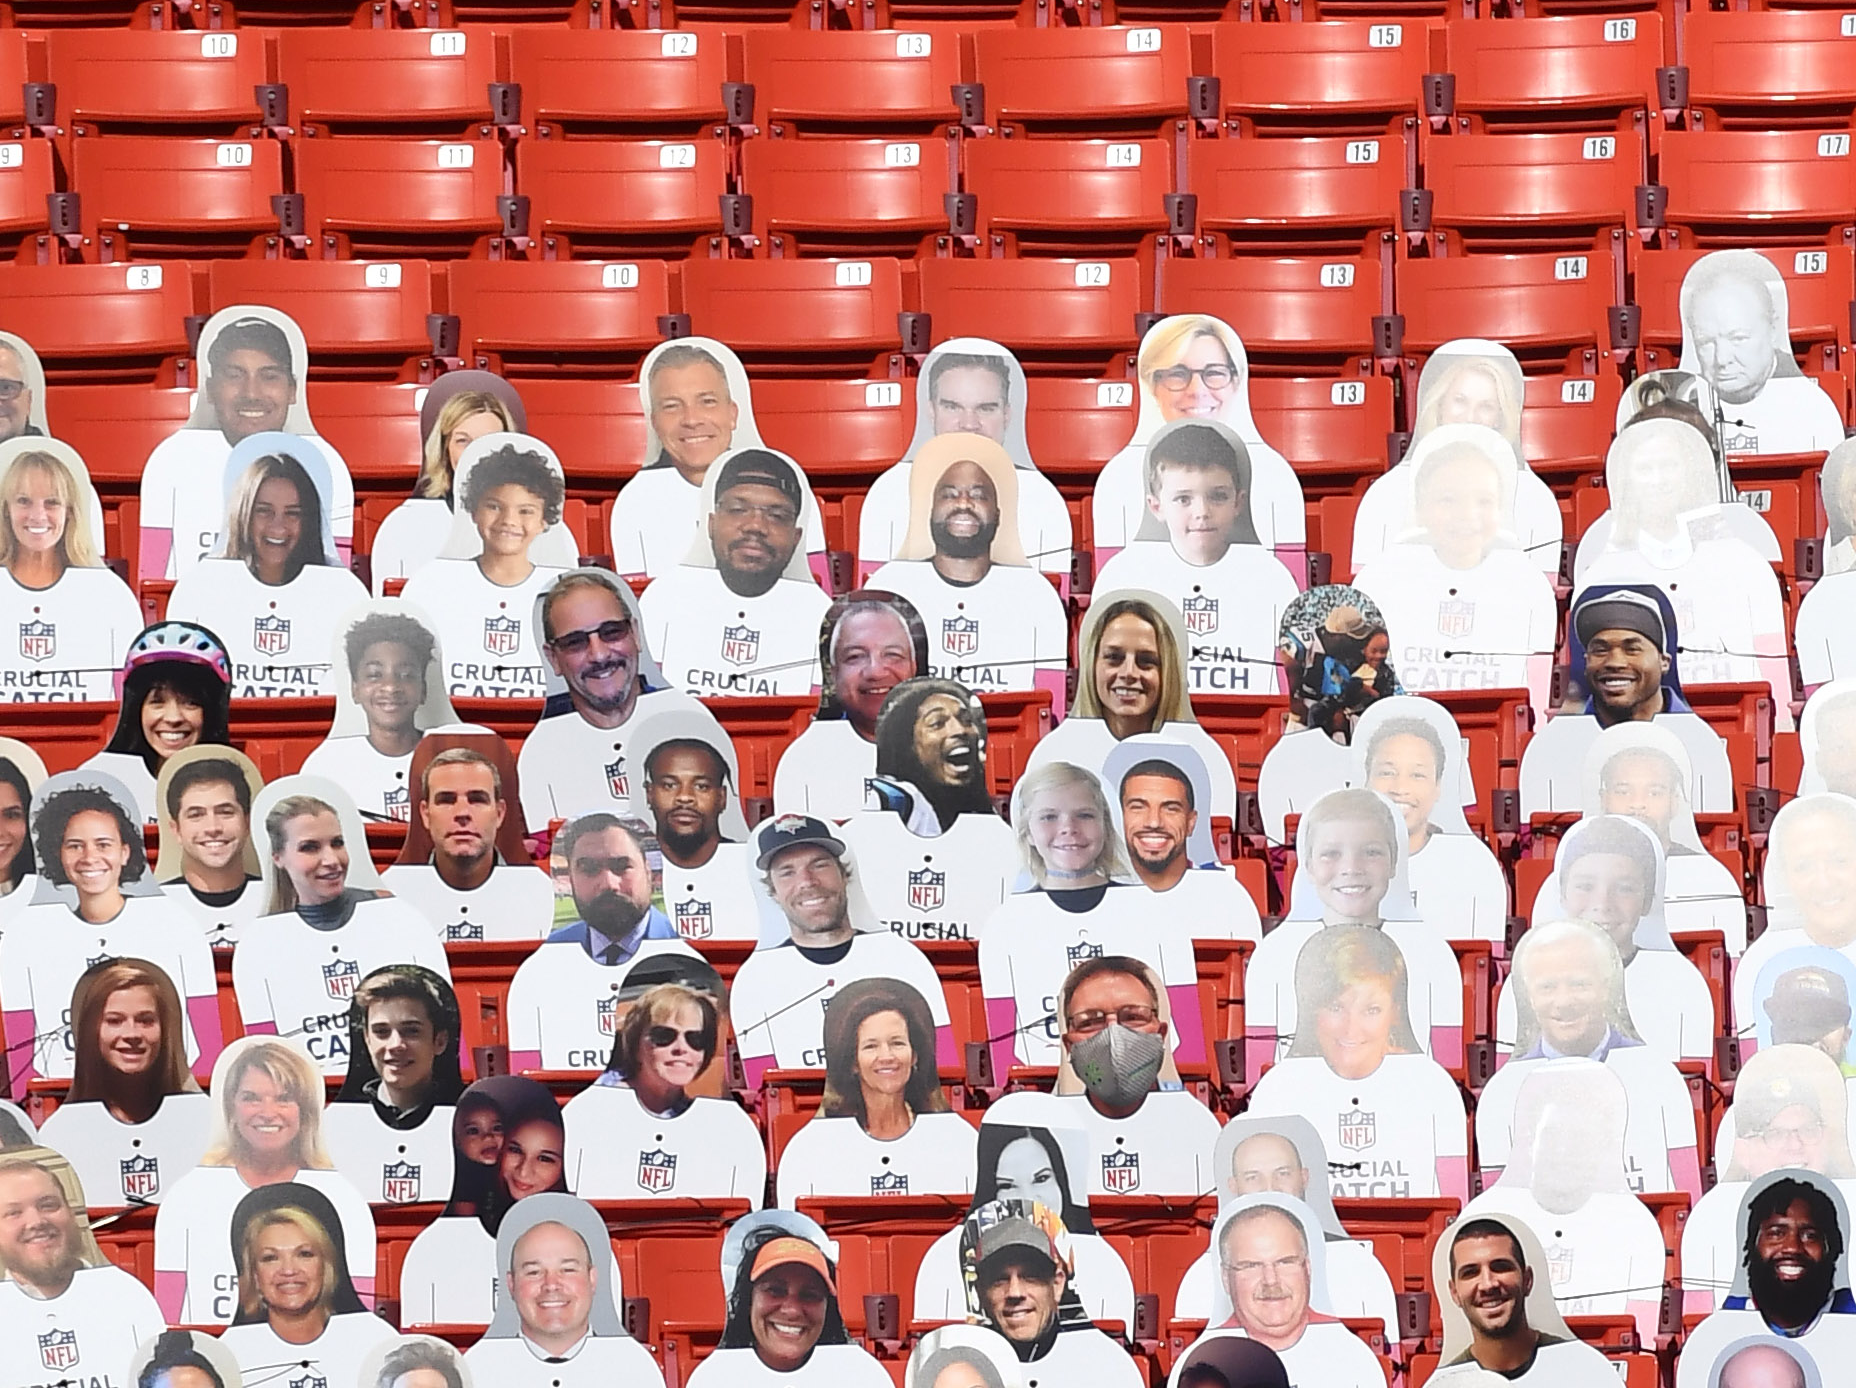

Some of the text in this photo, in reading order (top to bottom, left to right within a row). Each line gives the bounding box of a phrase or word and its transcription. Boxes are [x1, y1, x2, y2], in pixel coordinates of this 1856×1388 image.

[1377, 27, 1395, 45] 15
[1612, 21, 1629, 39] 16
[441, 36, 456, 53] 11
[1591, 139, 1609, 157] 16
[1825, 136, 1843, 154] 17
[1802, 254, 1820, 272] 15
[1330, 266, 1347, 285] 13
[1339, 384, 1357, 403] 13
[1569, 382, 1587, 401] 14
[1186, 611, 1215, 632] NFL
[23, 636, 52, 657] NFL
[258, 631, 288, 652] NFL
[487, 632, 517, 653] NFL
[725, 641, 755, 662] NFL
[946, 632, 976, 653] NFL
[236, 664, 321, 688] RUCIAL
[685, 667, 779, 696] CRUCIAL
[911, 885, 941, 906] NFL
[125, 1173, 155, 1194] NFL
[641, 1166, 671, 1188] NFL
[1106, 1168, 1136, 1189] NFL
[387, 1180, 417, 1201] NFL
[44, 1345, 75, 1366] NFL
